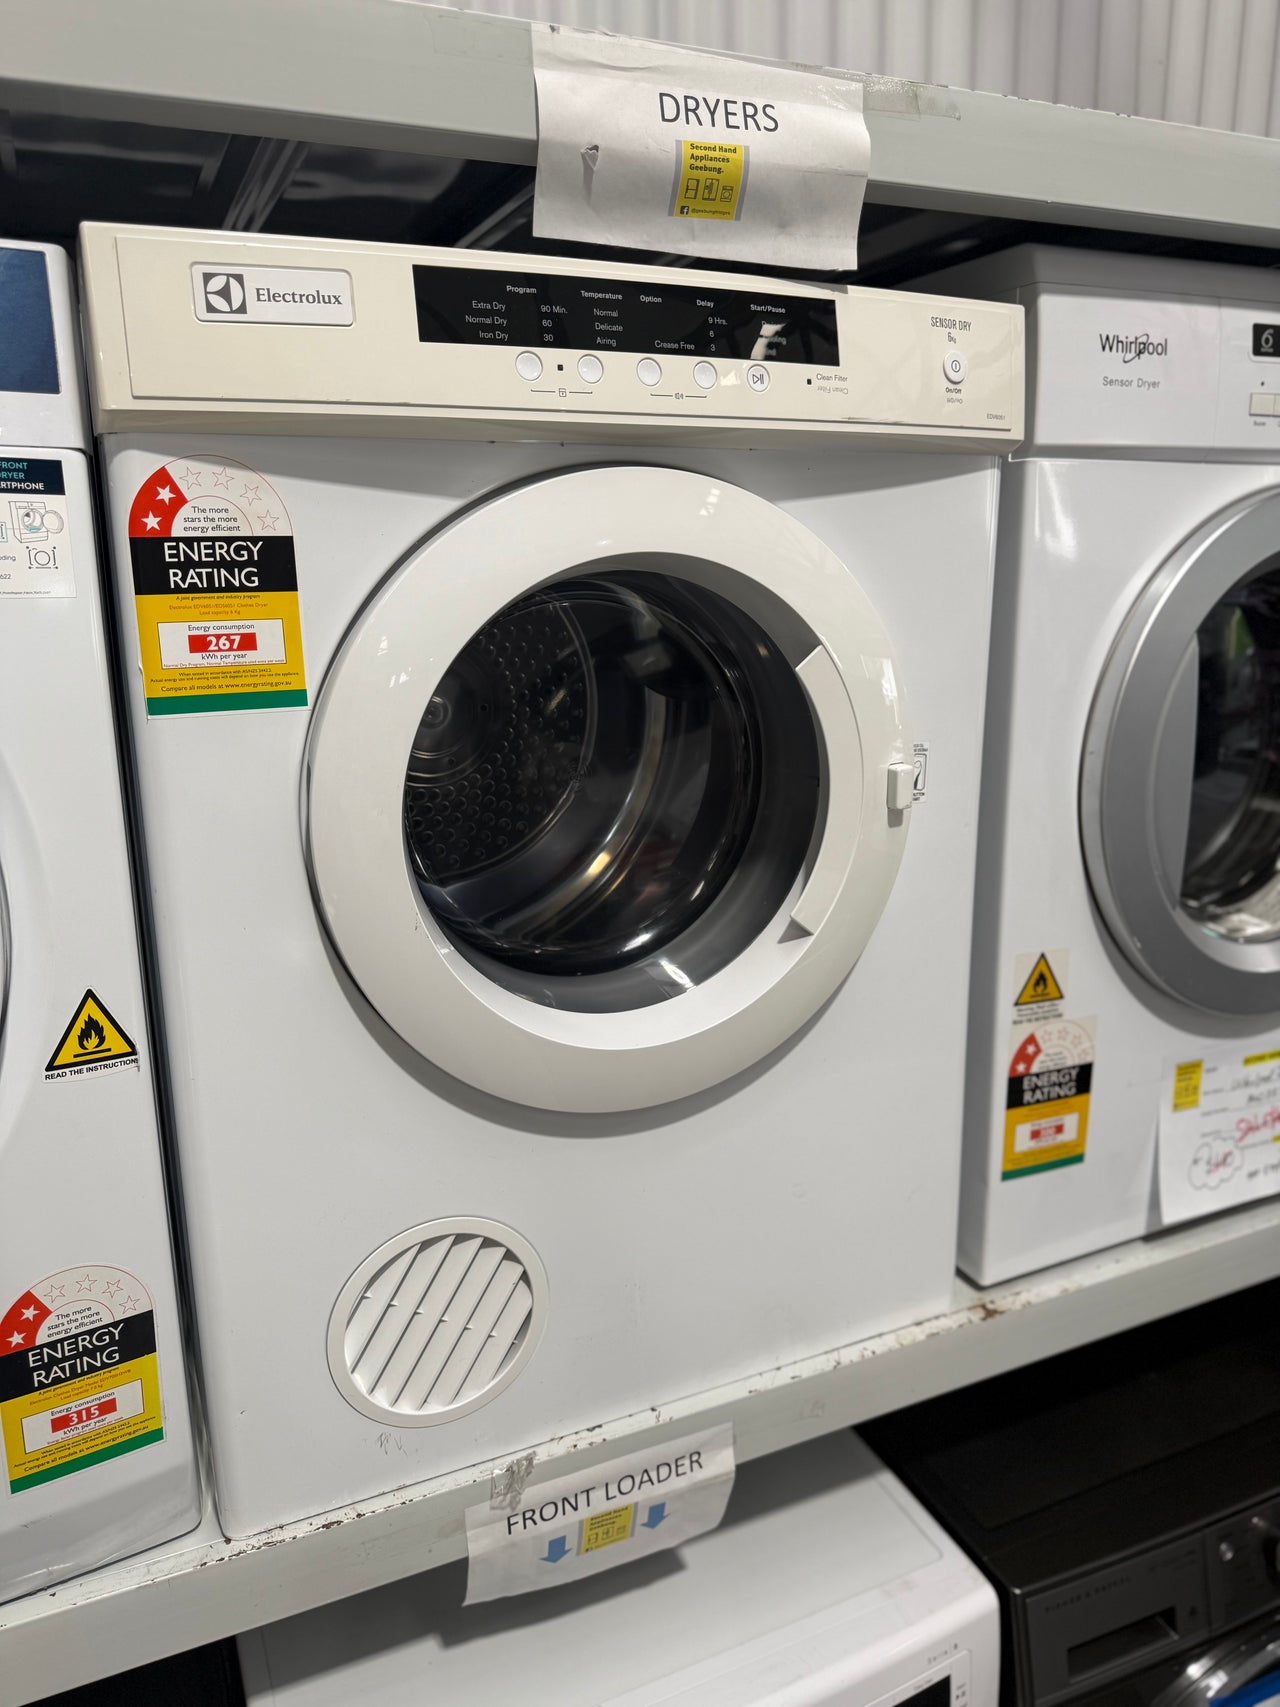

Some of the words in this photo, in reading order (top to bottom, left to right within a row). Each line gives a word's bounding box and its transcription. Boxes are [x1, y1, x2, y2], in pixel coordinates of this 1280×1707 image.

[659, 92, 779, 132] DRYERS
[690, 143, 716, 152] Second
[690, 154, 730, 163] Appliances
[690, 164, 724, 174] Geebung.
[506, 285, 537, 294] Program
[580, 290, 622, 300] Temperature
[256, 288, 343, 305] Electrolux
[640, 295, 662, 304] Option
[472, 301, 491, 309] Extra
[493, 302, 506, 312] Dry
[696, 299, 714, 308] Delay
[750, 304, 786, 314] Start/Pause
[552, 306, 568, 314] Min.
[593, 308, 618, 317] Normal
[465, 315, 492, 324] Normal
[494, 316, 507, 326] Dry
[714, 317, 728, 325] Hrs.
[931, 316, 957, 329] SENSOR
[958, 320, 972, 331] DRY
[595, 322, 623, 332] Delicate
[479, 330, 493, 339] Iron
[496, 331, 508, 341] Dry
[596, 337, 616, 347] Airing
[654, 340, 678, 349] Crease
[680, 341, 695, 350] Free
[1099, 334, 1168, 361] Whirlpool
[1102, 376, 1133, 387] Sensor
[1137, 378, 1160, 390] Dryer
[0, 471, 25, 480] RYER
[0, 481, 45, 490] RTPHONE
[184, 525, 209, 534] energy
[164, 541, 263, 562] ENERGY
[168, 568, 259, 589] RATING
[212, 623, 255, 631] consumption
[206, 635, 241, 651] 267
[45, 1072, 67, 1080] READ
[69, 1068, 84, 1076] THE
[1022, 1067, 1080, 1090] ENERGY
[1022, 1082, 1077, 1104] RATING
[72, 1307, 92, 1316] more
[47, 1322, 65, 1331] stars
[81, 1311, 100, 1320] more
[48, 1327, 72, 1338] energy
[75, 1318, 103, 1330] efficient
[28, 1323, 124, 1368] ENERGY
[33, 1347, 120, 1387] RATING
[51, 1406, 72, 1417] Energy
[74, 1391, 115, 1409] consumption
[69, 1406, 100, 1426] 315
[64, 1426, 79, 1435] kWh
[94, 1417, 108, 1426] year
[507, 1486, 596, 1535] FRONT
[605, 1451, 703, 1500] LOADER
